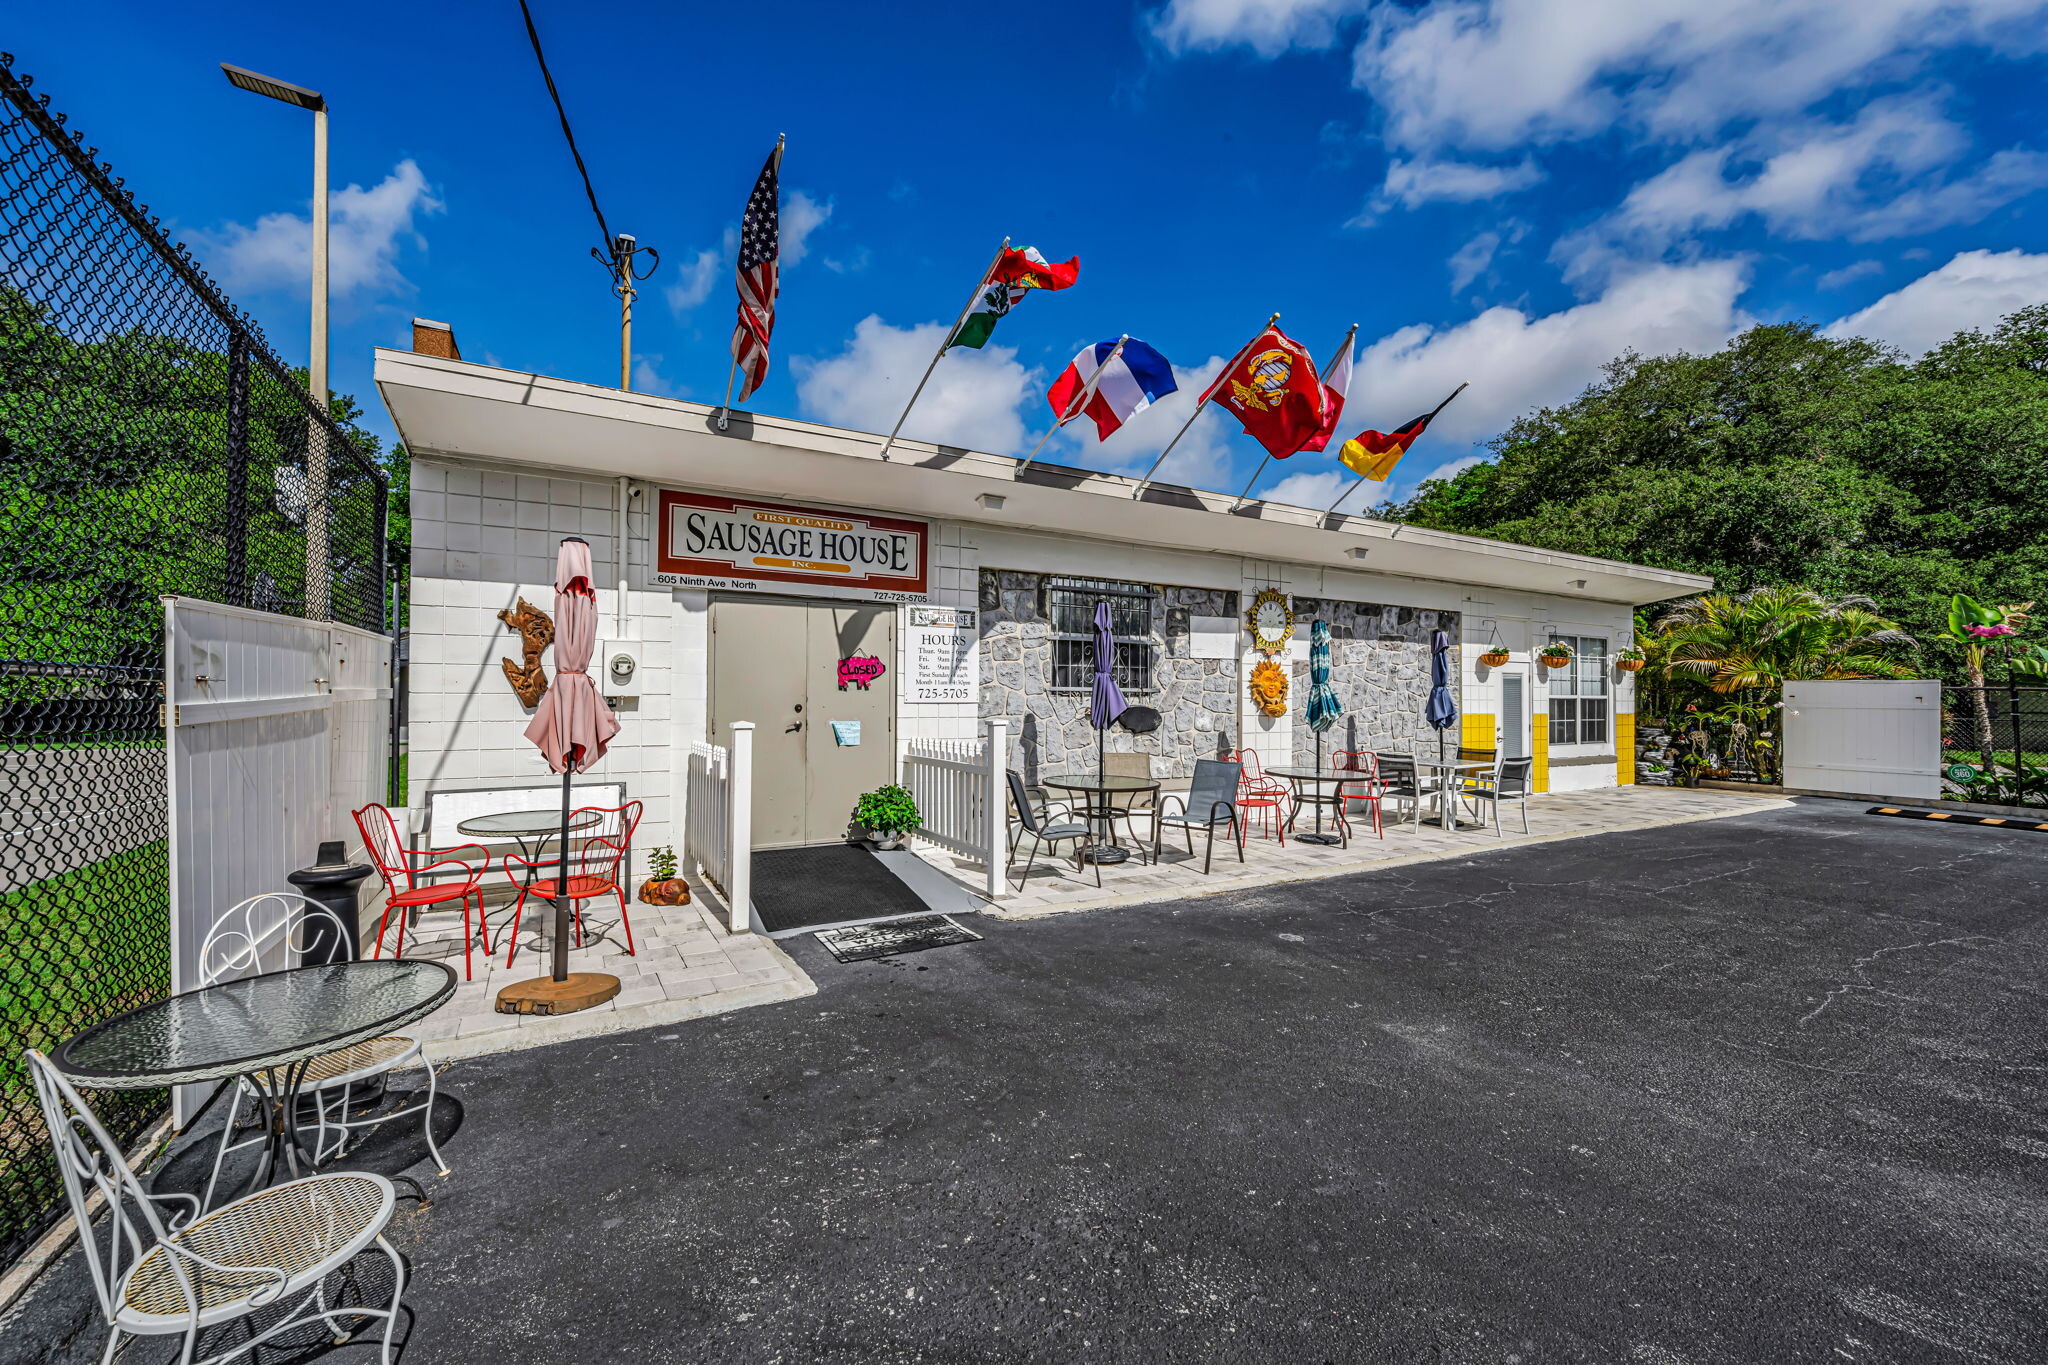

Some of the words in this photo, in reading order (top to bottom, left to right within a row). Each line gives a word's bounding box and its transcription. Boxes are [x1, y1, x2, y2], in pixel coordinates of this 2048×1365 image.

[756, 513, 792, 523] FIRST
[796, 518, 851, 530] QUALITY
[686, 513, 813, 559] SAUSAGE
[819, 532, 909, 571] HOUSE
[791, 560, 816, 569] INC.
[657, 575, 677, 584] 605
[679, 576, 705, 587] Ninth
[707, 578, 726, 588] Ave
[731, 580, 757, 590] North
[873, 592, 928, 603] 727-725-5705
[947, 614, 968, 626] HOUSE
[921, 634, 967, 646] HOURS
[840, 664, 878, 675] CLOSED
[918, 688, 969, 699] 725-5705
